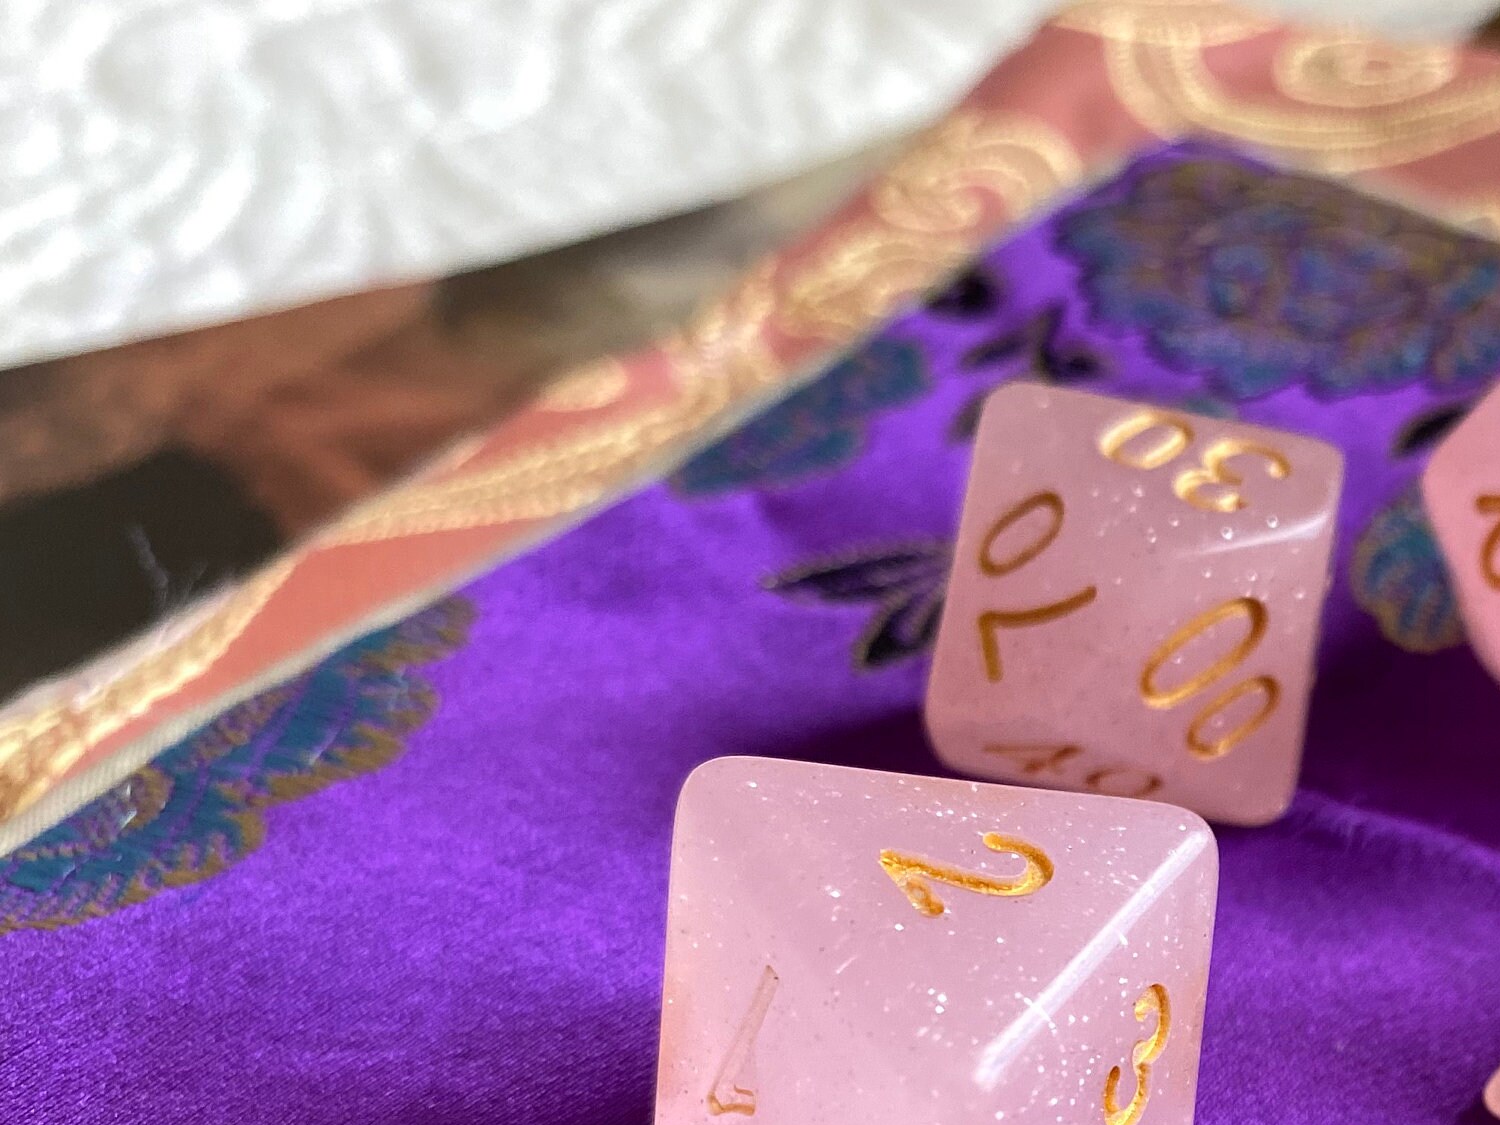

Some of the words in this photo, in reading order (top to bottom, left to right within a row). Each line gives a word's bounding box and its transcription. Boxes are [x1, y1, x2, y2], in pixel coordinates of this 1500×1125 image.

[1098, 409, 1292, 513] 30
[977, 490, 1097, 683] 70
[1139, 596, 1281, 762] 00
[877, 831, 1055, 918] 2
